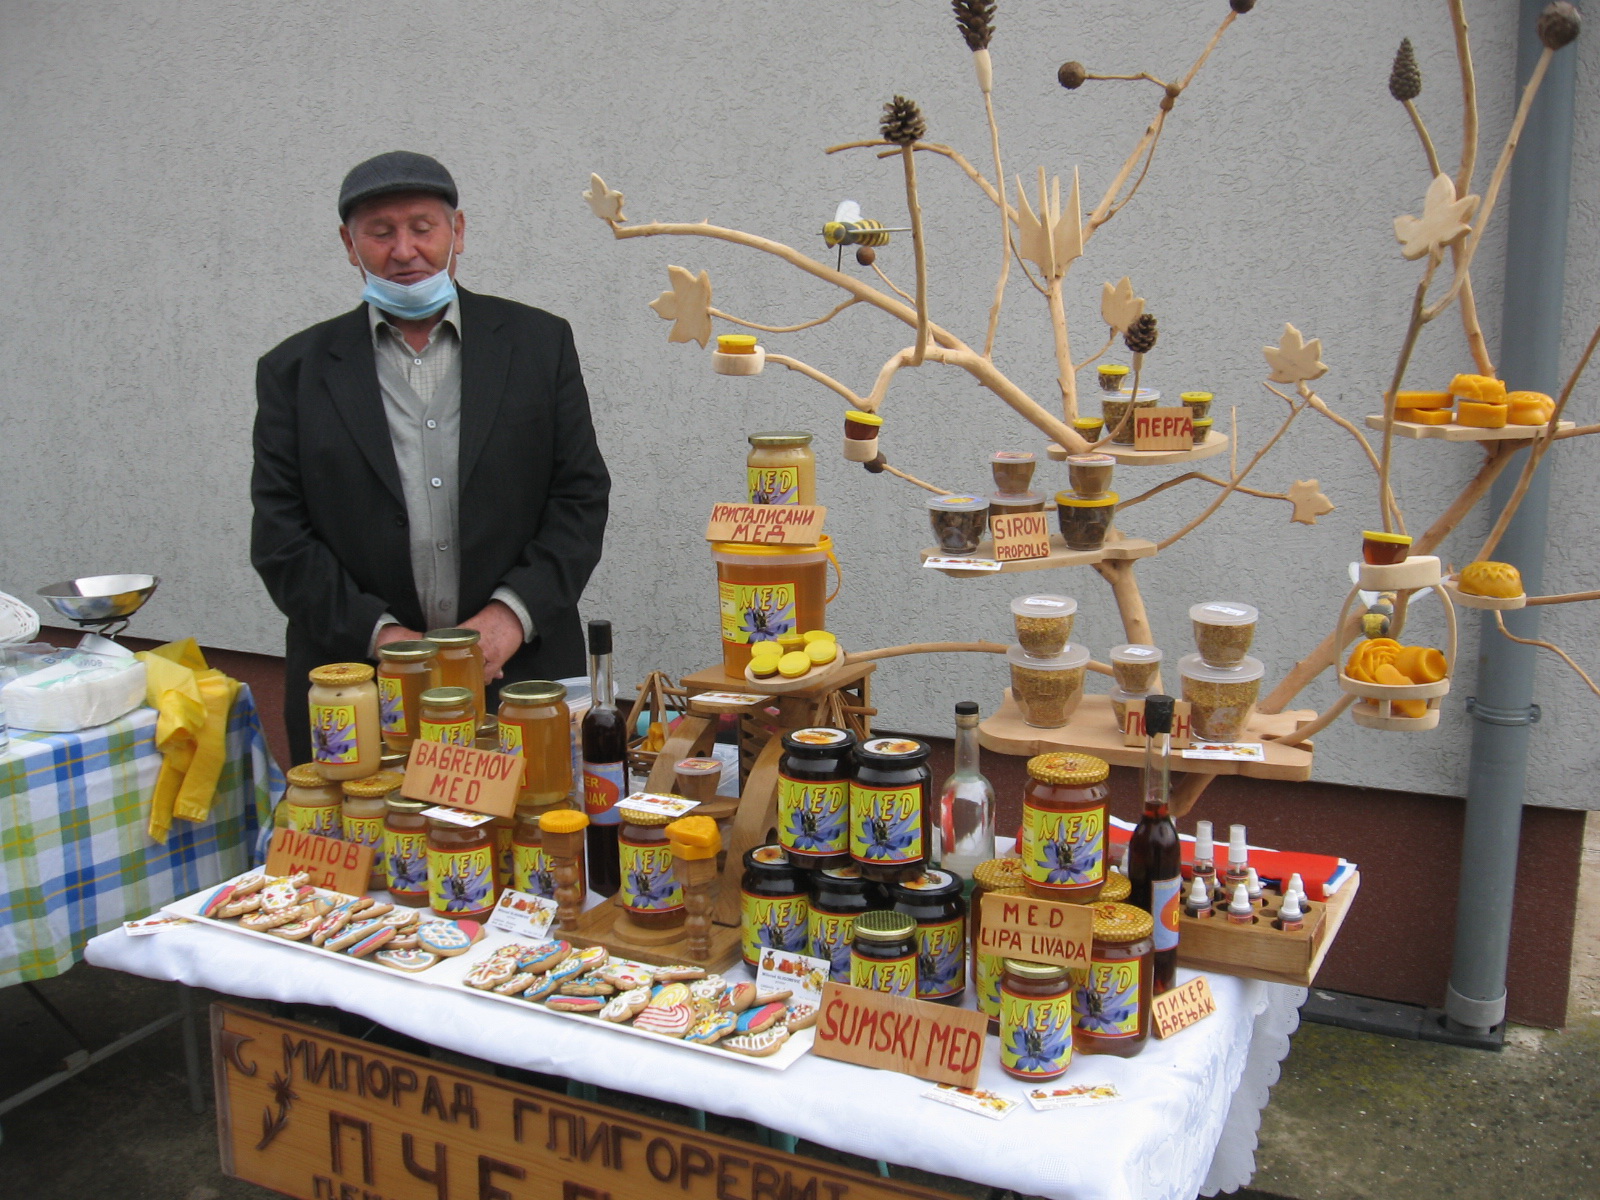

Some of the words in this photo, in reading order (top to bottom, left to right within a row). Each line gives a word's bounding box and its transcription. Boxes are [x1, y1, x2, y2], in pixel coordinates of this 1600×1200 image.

[1136, 416, 1194, 438] ПЕРГА
[750, 470, 793, 494] MED
[711, 505, 815, 526] КРИСТАЛИСАНИ
[994, 516, 1046, 540] SIROVI
[731, 524, 786, 543] МЕД
[997, 541, 1049, 560] PROPOLIS
[739, 587, 789, 611] MED
[416, 743, 515, 781] BAGREMOV
[429, 773, 481, 805] MED
[787, 784, 844, 815] MED
[857, 791, 914, 822] MED
[1038, 813, 1098, 845] MED
[277, 829, 360, 870] ЛИПОВ
[437, 850, 487, 879] MED
[623, 849, 672, 874] MED
[753, 900, 809, 928] MED
[1003, 902, 1064, 929] MED
[981, 927, 1022, 951] LIPA
[1031, 935, 1087, 963] LIVADA
[856, 962, 912, 993] MED
[1156, 980, 1204, 1020] ЛИКЕР
[1008, 1000, 1068, 1032] MED
[1161, 997, 1214, 1037] ДРЕЊАК
[820, 990, 921, 1061] ŠUMSKI
[925, 1021, 982, 1075] MED
[282, 1033, 479, 1130] МИЛОРАД
[328, 1110, 612, 1200] ПЧЕ
